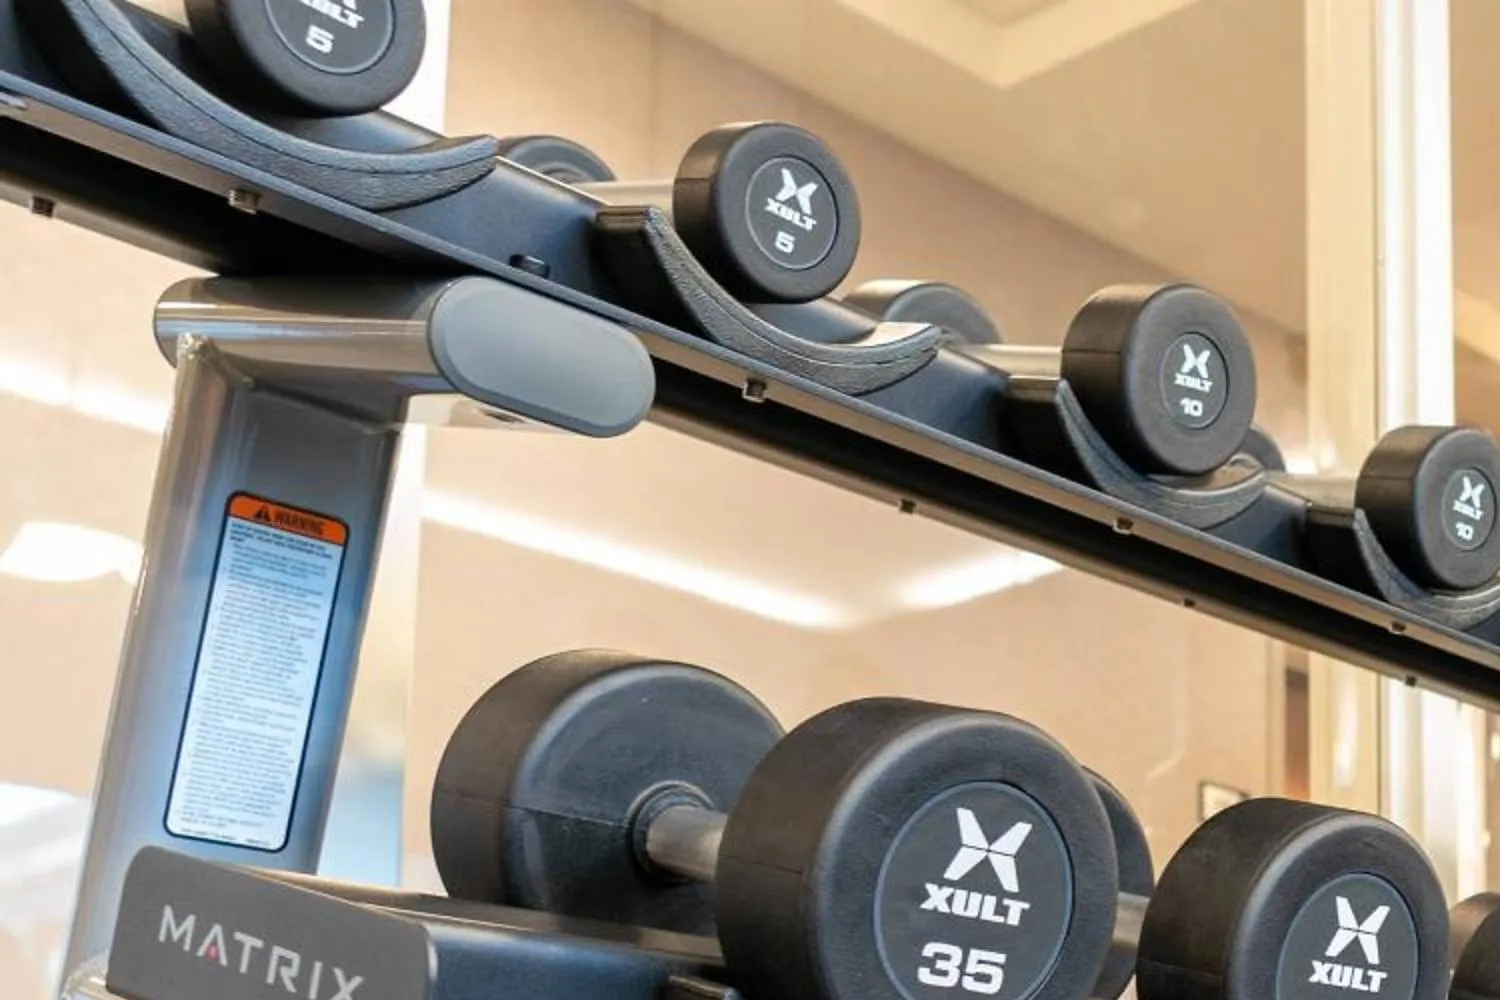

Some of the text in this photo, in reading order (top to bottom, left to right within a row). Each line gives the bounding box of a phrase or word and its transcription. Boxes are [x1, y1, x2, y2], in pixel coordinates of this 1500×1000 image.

[306, 25, 335, 53] 5
[765, 197, 818, 232] XULT
[1179, 397, 1204, 418] 10
[1455, 521, 1475, 542] 10
[919, 882, 1031, 927] XULT
[917, 941, 1007, 995] 35
[1308, 959, 1388, 993] XULT
